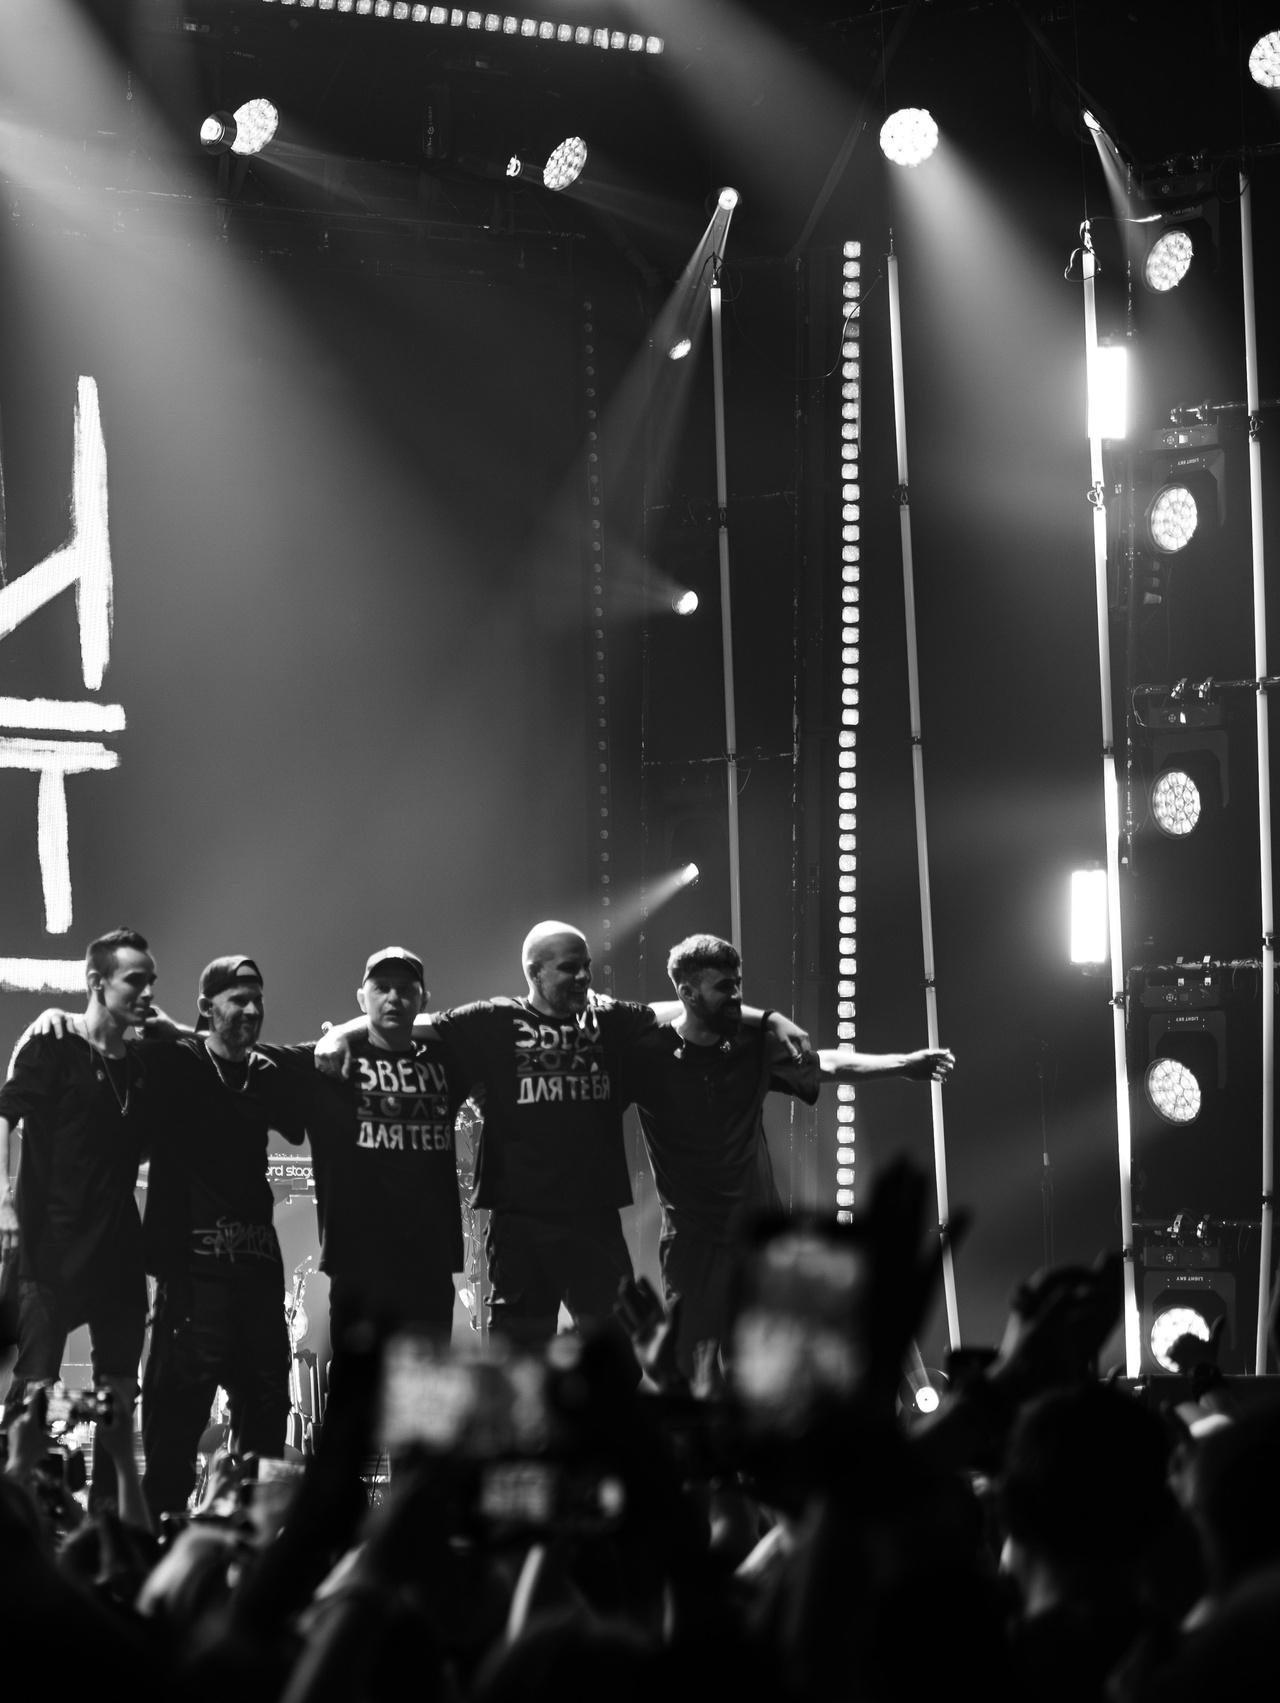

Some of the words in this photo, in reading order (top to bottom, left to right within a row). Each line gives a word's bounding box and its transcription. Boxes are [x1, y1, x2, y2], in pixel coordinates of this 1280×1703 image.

[355, 1057, 448, 1094] ЗВЕРИ
[517, 1076, 563, 1104] ДЛЯ
[565, 1075, 610, 1101] ТЕБЯ
[356, 1121, 404, 1151] ДЛЯ
[406, 1124, 452, 1151] ТЕБЯ
